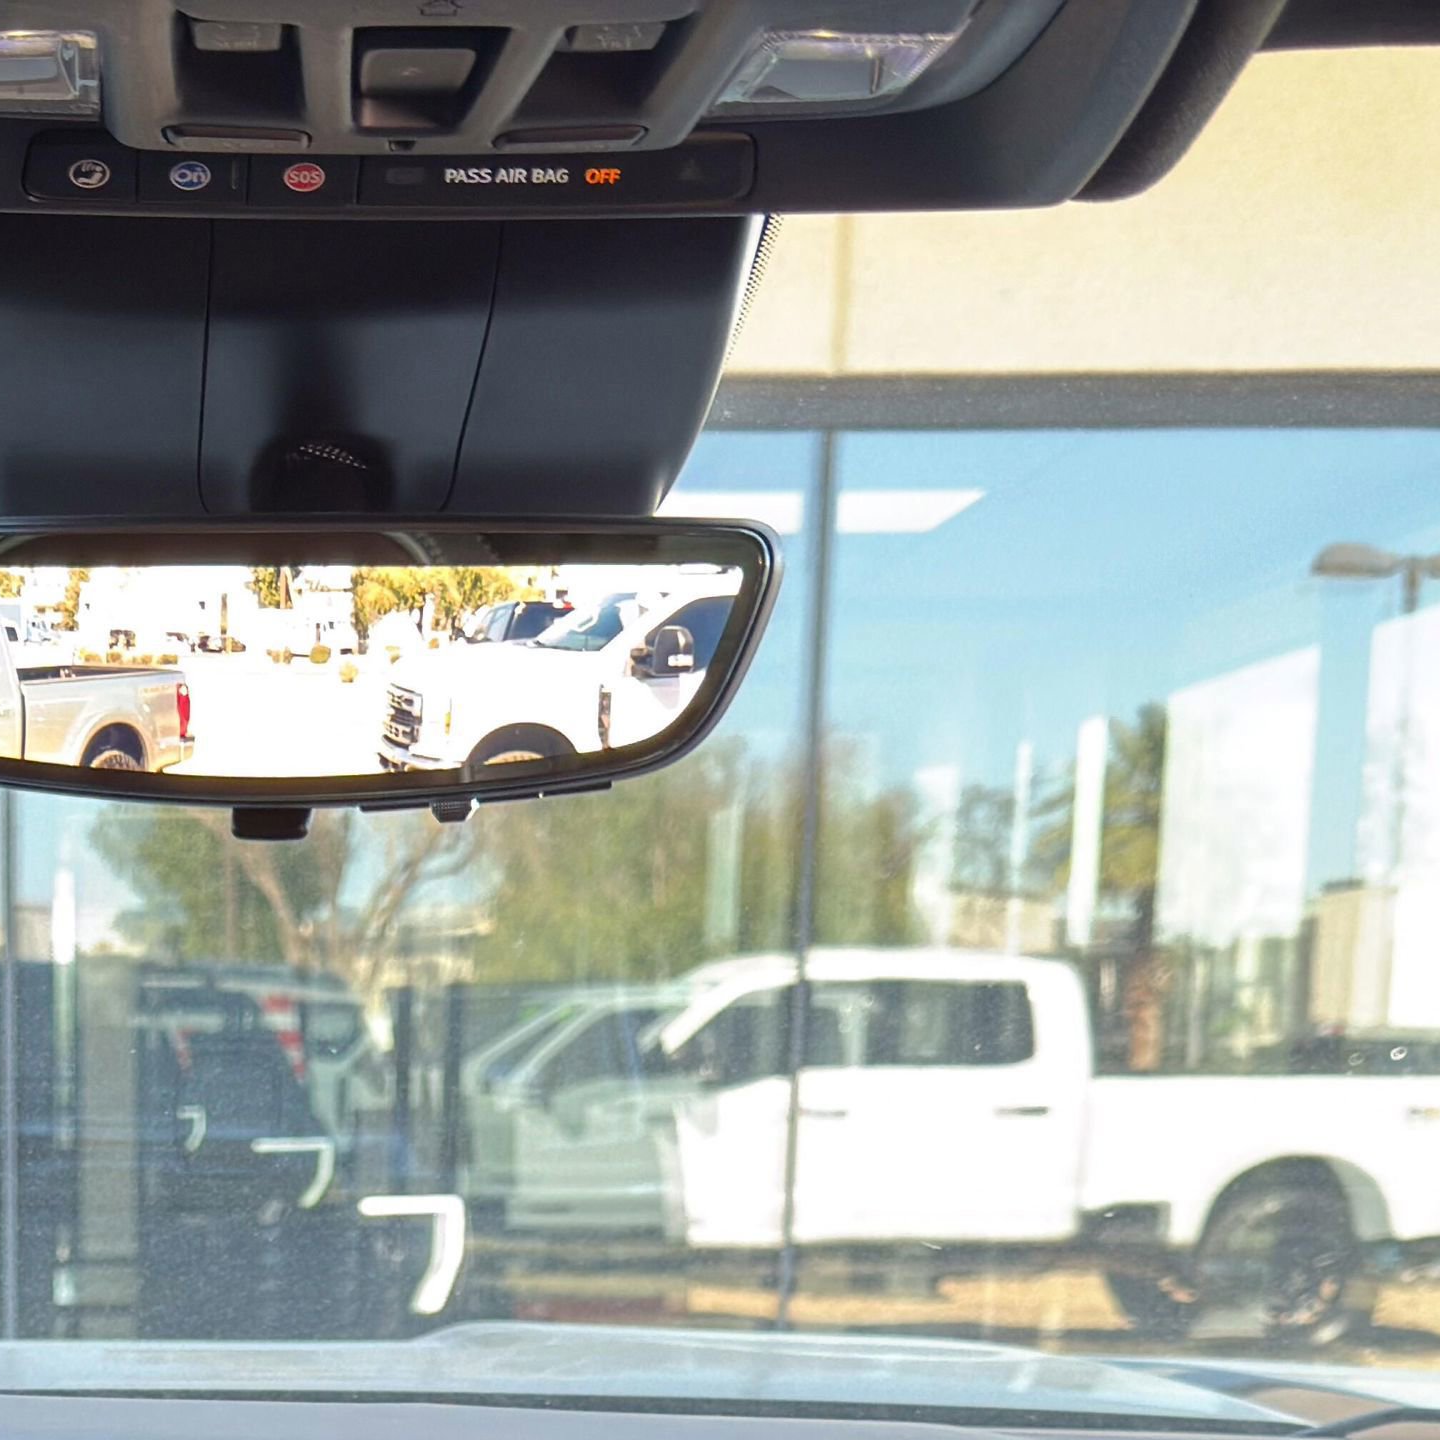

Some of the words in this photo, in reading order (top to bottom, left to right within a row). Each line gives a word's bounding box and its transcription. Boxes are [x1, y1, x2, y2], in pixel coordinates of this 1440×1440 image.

[288, 169, 321, 184] SOS
[445, 168, 492, 184] PASS
[496, 168, 527, 184] AIR
[532, 168, 569, 184] BAG
[585, 168, 621, 184] OFF
